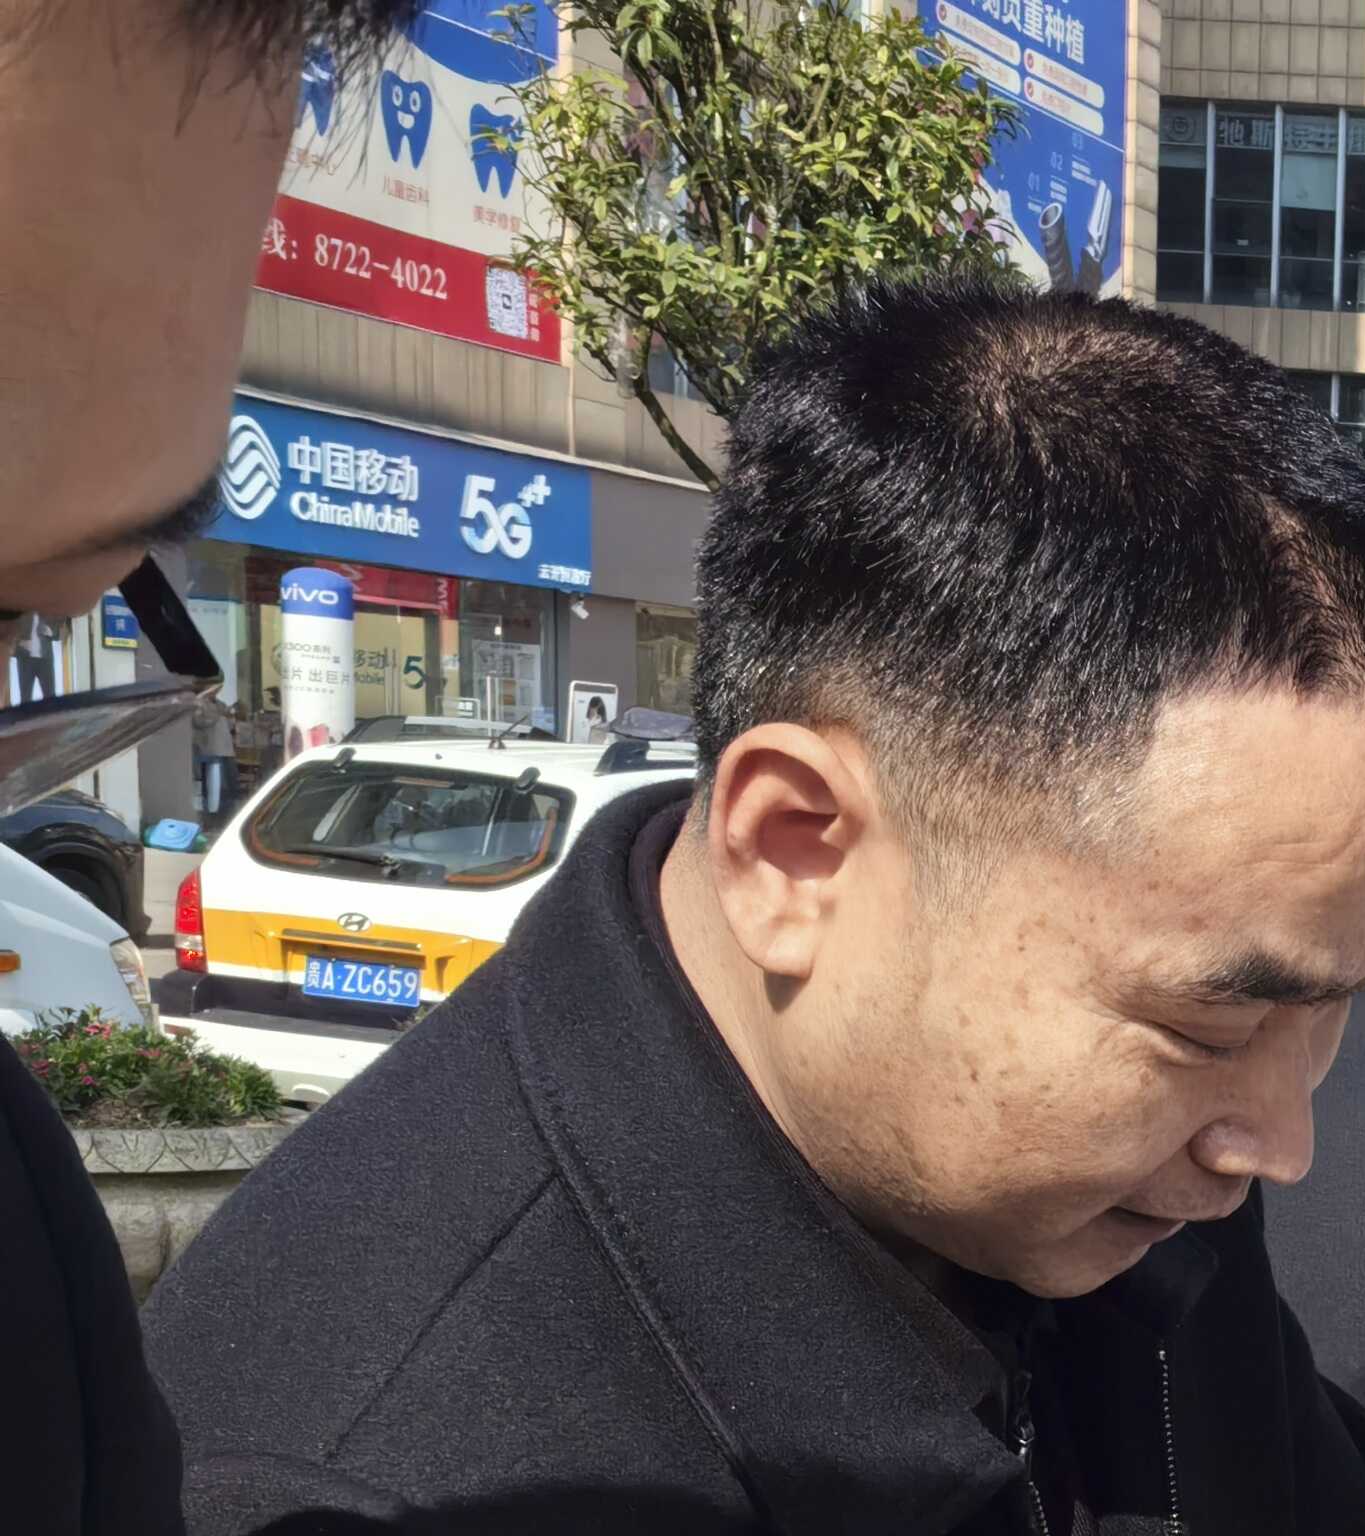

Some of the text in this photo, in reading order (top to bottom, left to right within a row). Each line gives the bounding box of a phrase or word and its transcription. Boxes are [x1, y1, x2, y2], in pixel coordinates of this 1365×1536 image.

[288, 436, 419, 502] 中国移动
[280, 582, 339, 605] vivo
